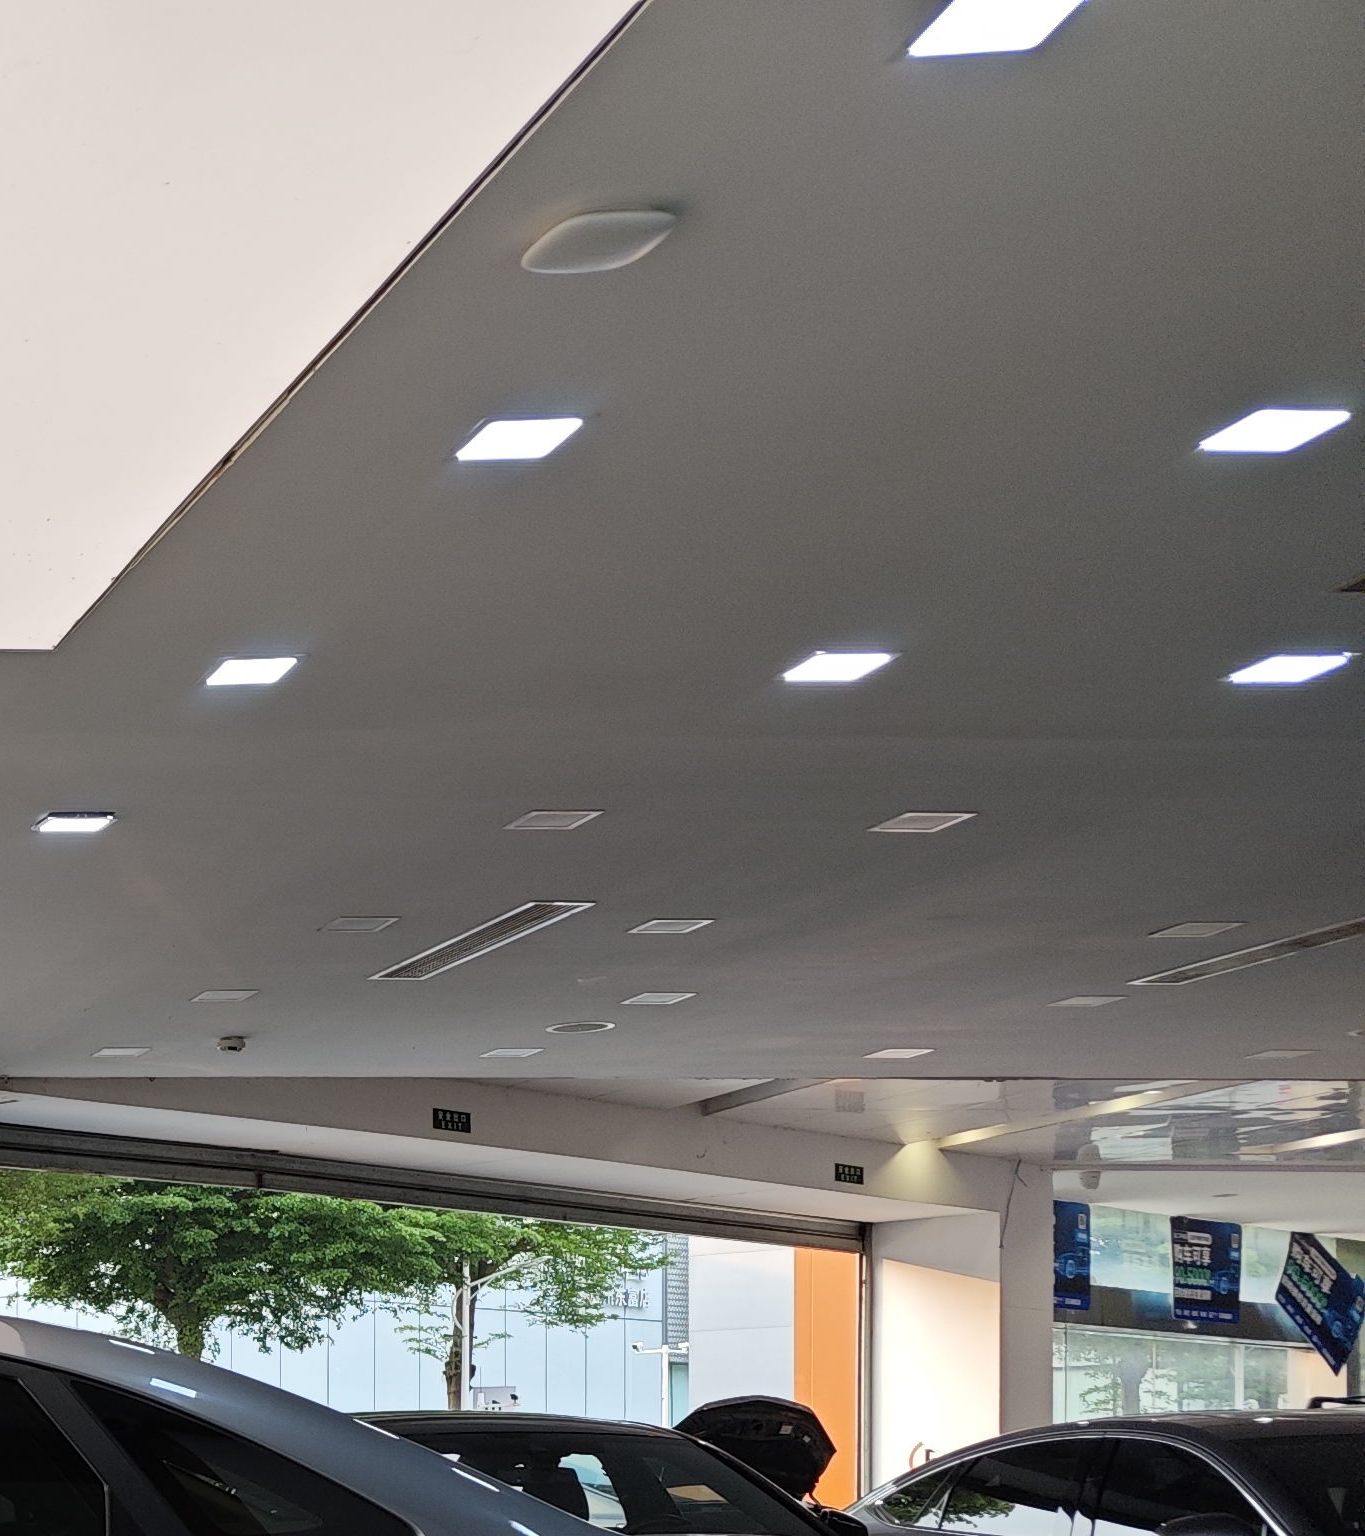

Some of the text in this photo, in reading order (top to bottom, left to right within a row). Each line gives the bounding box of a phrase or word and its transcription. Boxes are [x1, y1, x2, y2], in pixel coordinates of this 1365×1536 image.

[437, 1110, 467, 1123] 安全出口
[441, 1120, 463, 1131] EXIT
